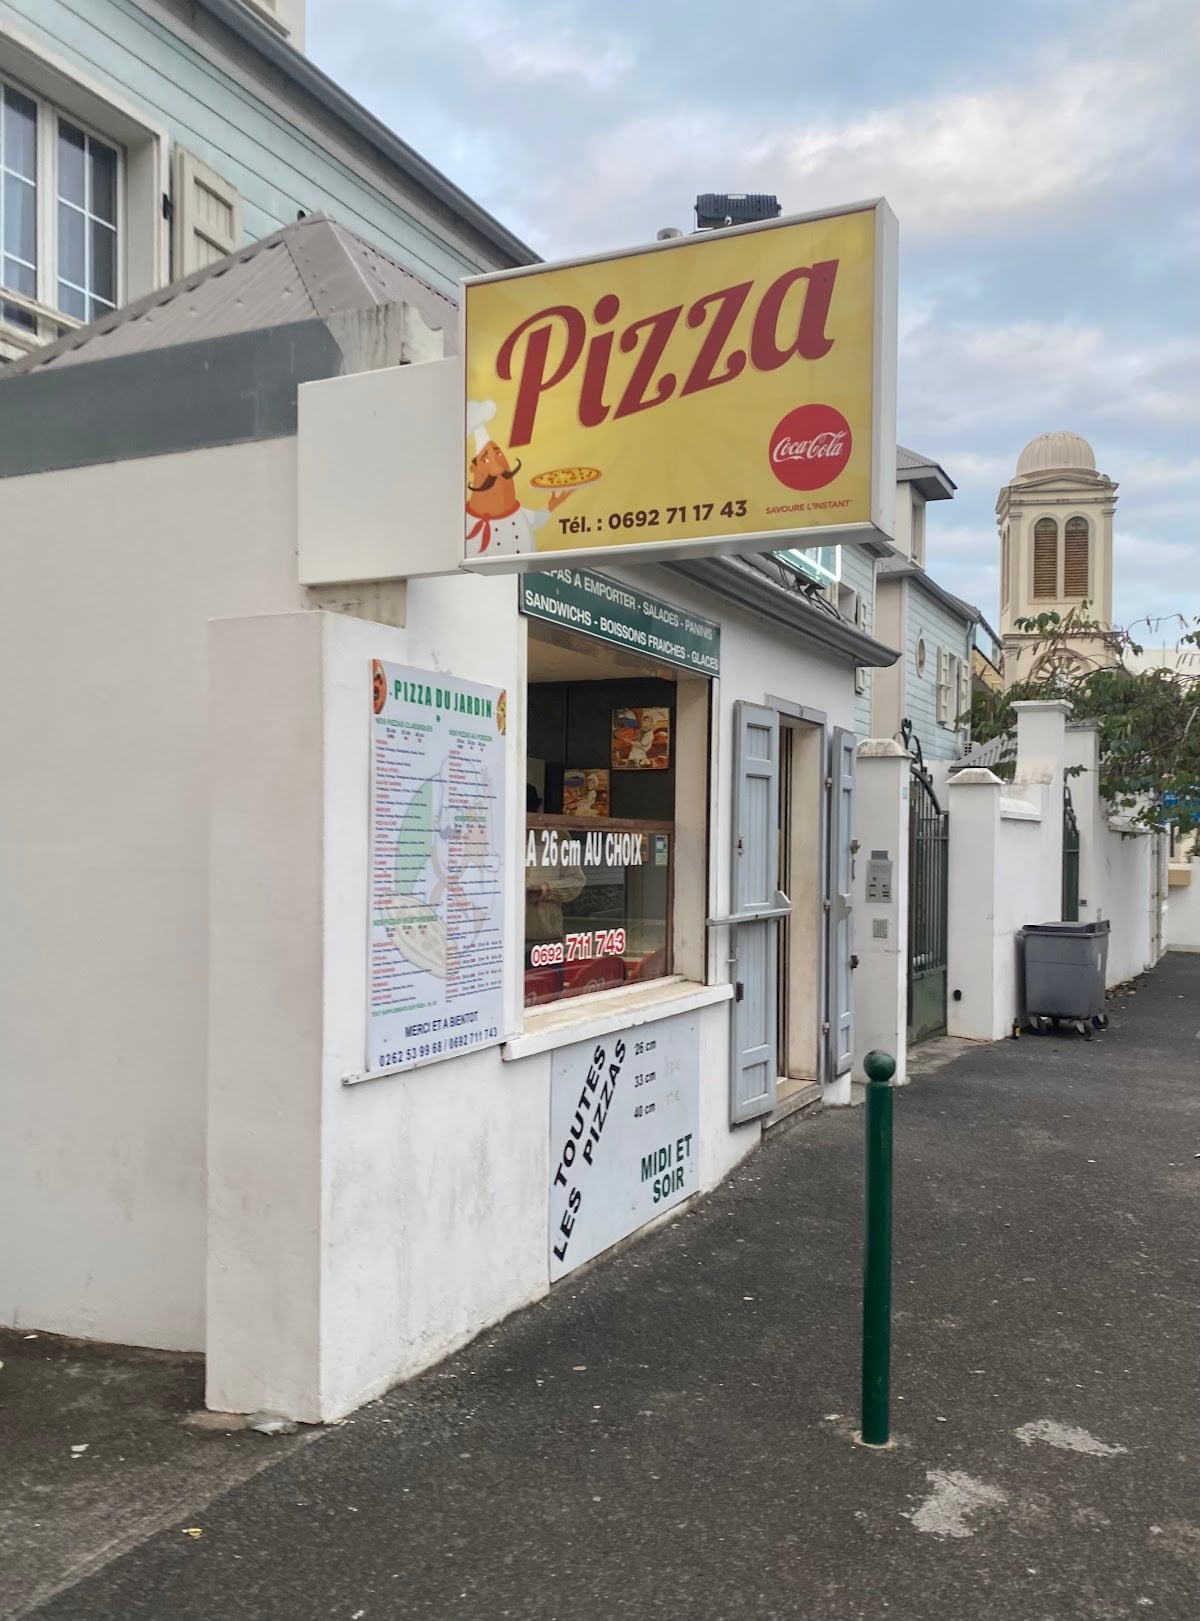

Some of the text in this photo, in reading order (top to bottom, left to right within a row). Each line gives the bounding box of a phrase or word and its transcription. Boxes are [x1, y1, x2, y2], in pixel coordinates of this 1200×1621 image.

[496, 258, 839, 448] Pizza
[773, 431, 848, 462] Coca-Cola
[559, 516, 591, 534] Tél.
[608, 509, 660, 529] 0692
[666, 506, 687, 524] 71
[693, 503, 714, 521] 17
[720, 500, 747, 517] 43
[765, 500, 850, 514] SAVOURE L'INSTANT
[574, 573, 582, 588] A
[584, 576, 636, 610] EMPORTER
[642, 601, 679, 627] SALADES
[525, 590, 592, 627] SANDWICHS
[600, 617, 647, 645] BOISSONS
[648, 634, 686, 659] FRAICHES
[691, 651, 719, 670] GLACES
[394, 679, 492, 718] PIZZA DU JARDIN
[541, 830, 558, 866] 26
[561, 839, 580, 866] cm
[584, 832, 602, 866] AU
[605, 833, 642, 866] CHOIX
[531, 928, 626, 967] 0692 711 743
[379, 1051, 403, 1067] 0262
[406, 1047, 417, 1060] 53
[420, 1044, 430, 1057] 99
[449, 1034, 468, 1049] 0692
[470, 1031, 482, 1044] 711
[485, 1027, 498, 1040] 743
[405, 1022, 431, 1038] MERCI
[432, 1019, 442, 1032] ET
[443, 1018, 449, 1029] A
[634, 1040, 657, 1056] 26 cm
[634, 1071, 657, 1088] 33 cm
[553, 1045, 606, 1187] TOUTES
[645, 1102, 656, 1114] cm
[553, 1039, 626, 1262] LES PIZZAS
[641, 1133, 693, 1182] MIDI ET
[653, 1166, 685, 1204] SOIR
